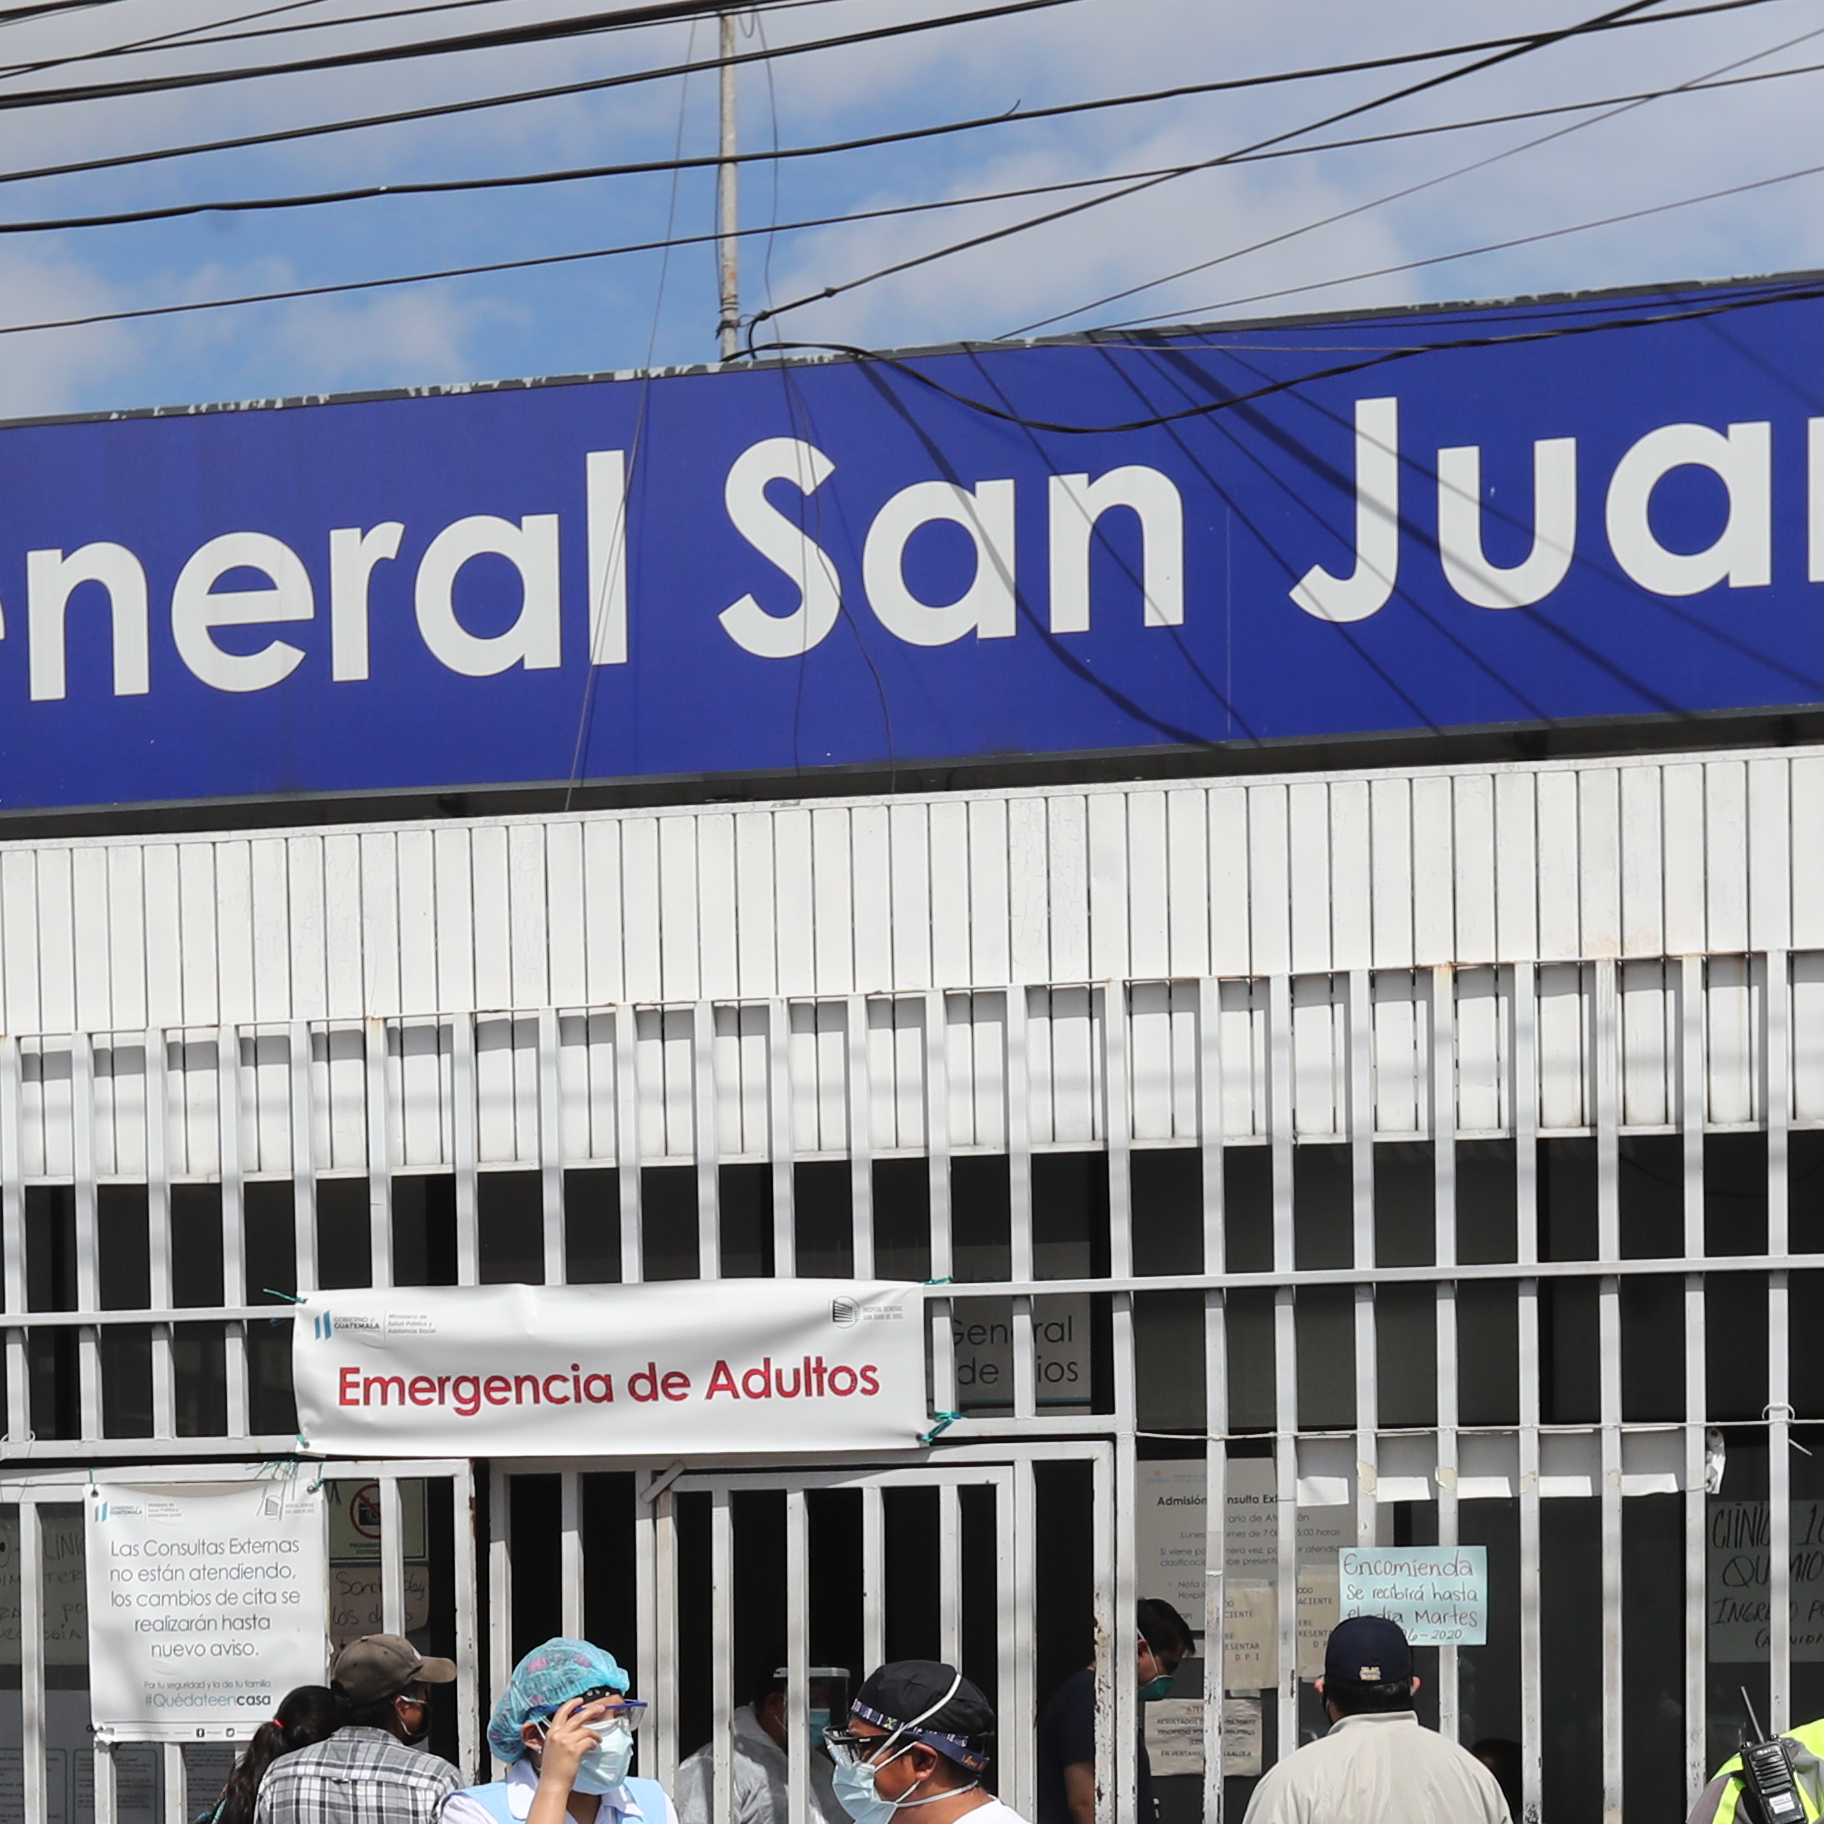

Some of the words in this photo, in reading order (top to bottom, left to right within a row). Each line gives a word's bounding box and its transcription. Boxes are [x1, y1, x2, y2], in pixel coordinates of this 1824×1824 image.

[718, 438, 1184, 658] San
[953, 1316, 1072, 1346] Genral
[958, 1358, 999, 1385] de
[1037, 1355, 1079, 1383] ios
[339, 1363, 613, 1416] Emergencia
[627, 1361, 691, 1401] de
[705, 1355, 880, 1400] Adultos
[1157, 1494, 1208, 1506] Admisión
[1228, 1493, 1260, 1505] nsulta
[1316, 1528, 1340, 1537] horas
[111, 1540, 139, 1557] Las
[143, 1539, 225, 1557] Consultas
[229, 1538, 300, 1555] Externas
[1160, 1557, 1206, 1566] clasificació
[1343, 1550, 1474, 1578] Encomienda
[110, 1568, 133, 1582] no
[137, 1563, 185, 1582] están
[189, 1562, 297, 1581] atendiendo,
[111, 1590, 132, 1607] los
[136, 1589, 211, 1607] cambios
[215, 1589, 239, 1606] de
[242, 1588, 277, 1606] cita
[281, 1590, 301, 1605] se
[1178, 1591, 1206, 1600] Hospit
[1298, 1597, 1332, 1605] ACIENTE
[1346, 1583, 1365, 1601] Se
[1431, 1581, 1478, 1602] hasta
[134, 1613, 217, 1632] realizarán
[222, 1613, 271, 1631] hasta
[1415, 1605, 1478, 1627] Martes
[151, 1642, 206, 1658] nuevo
[210, 1639, 259, 1657] aviso.
[167, 1681, 205, 1691] seguridad
[244, 1679, 271, 1688] familia
[145, 1693, 271, 1708] #Quédateencasa
